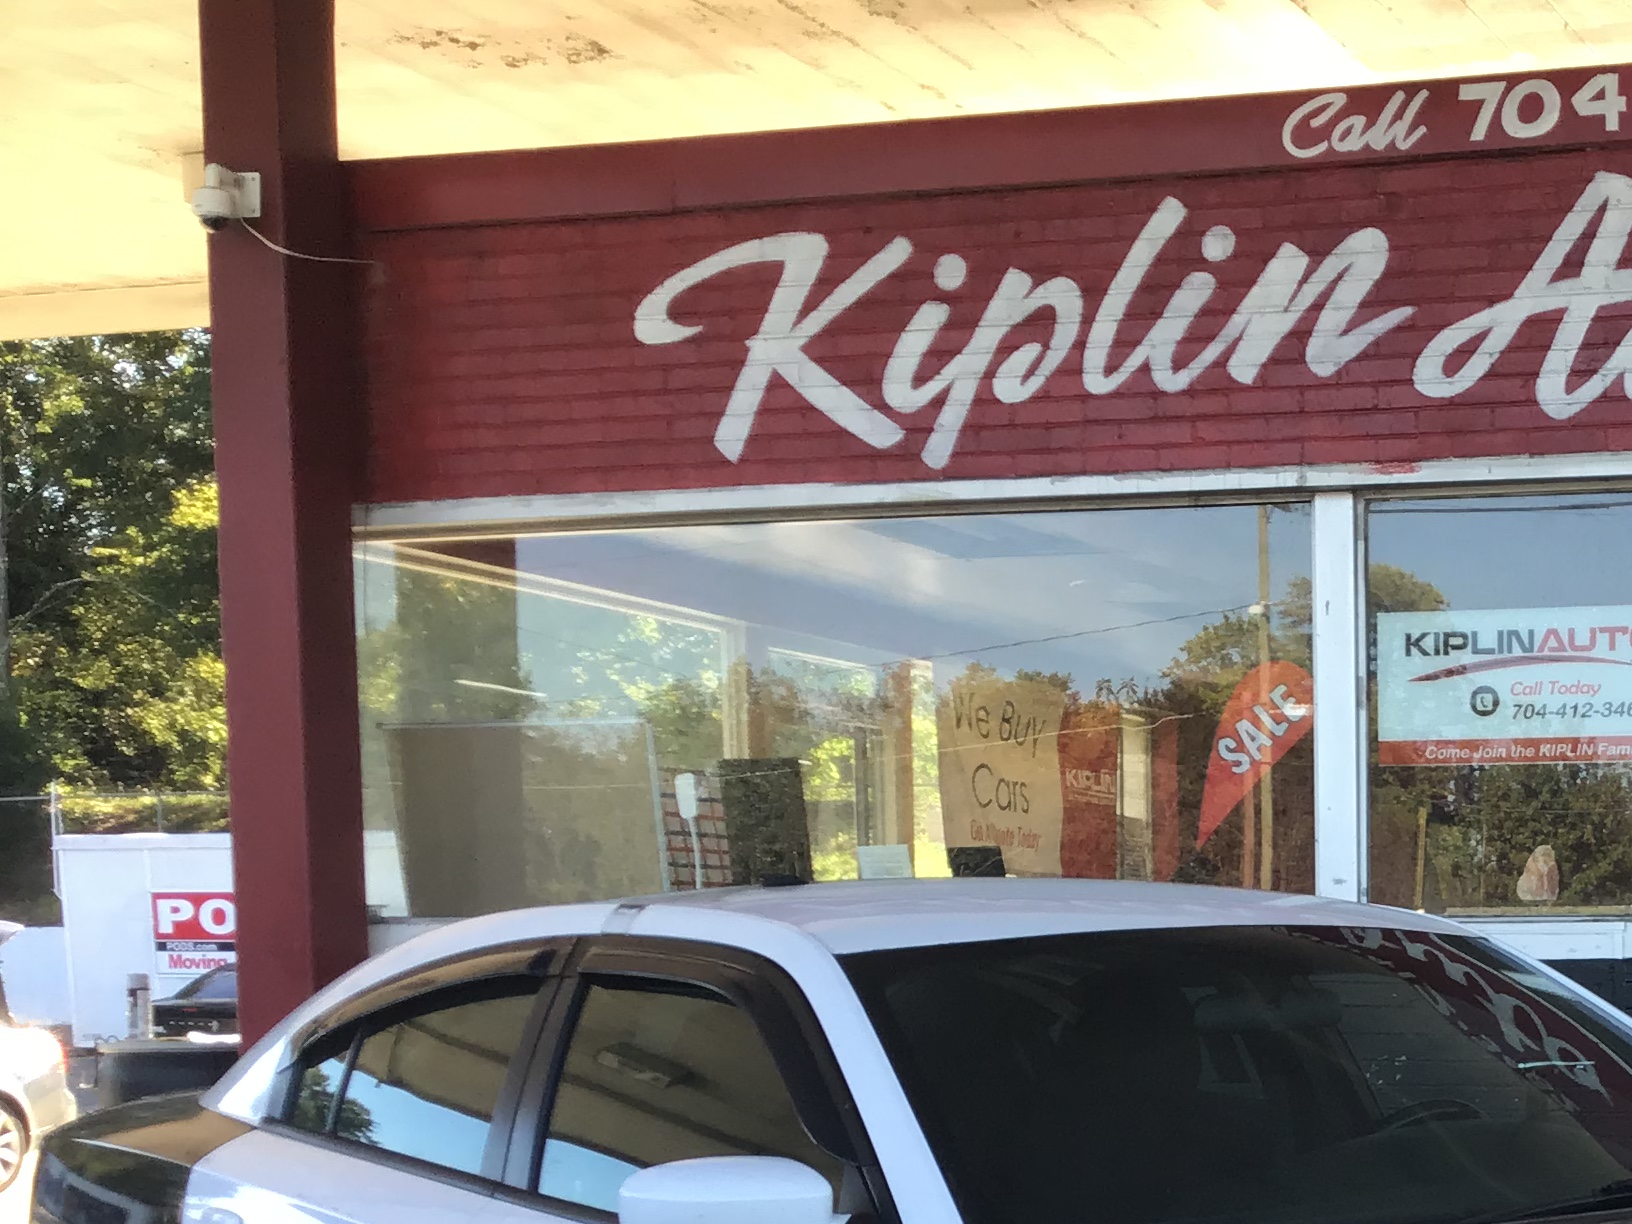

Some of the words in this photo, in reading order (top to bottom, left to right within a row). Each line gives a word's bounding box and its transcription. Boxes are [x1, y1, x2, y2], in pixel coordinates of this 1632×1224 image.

[1281, 89, 1427, 158] Call
[632, 195, 1418, 470] Kiplin
[1510, 681, 1543, 696] Call
[1548, 680, 1601, 698] Today
[955, 692, 990, 740] We
[999, 700, 1047, 758] Buy
[1217, 683, 1307, 774] SALE
[1425, 745, 1469, 759] Come
[1473, 744, 1506, 758] Join
[1510, 744, 1535, 757] the
[1539, 743, 1594, 757] KIPLIN
[971, 762, 1030, 815] Cars
[156, 898, 237, 936] PO
